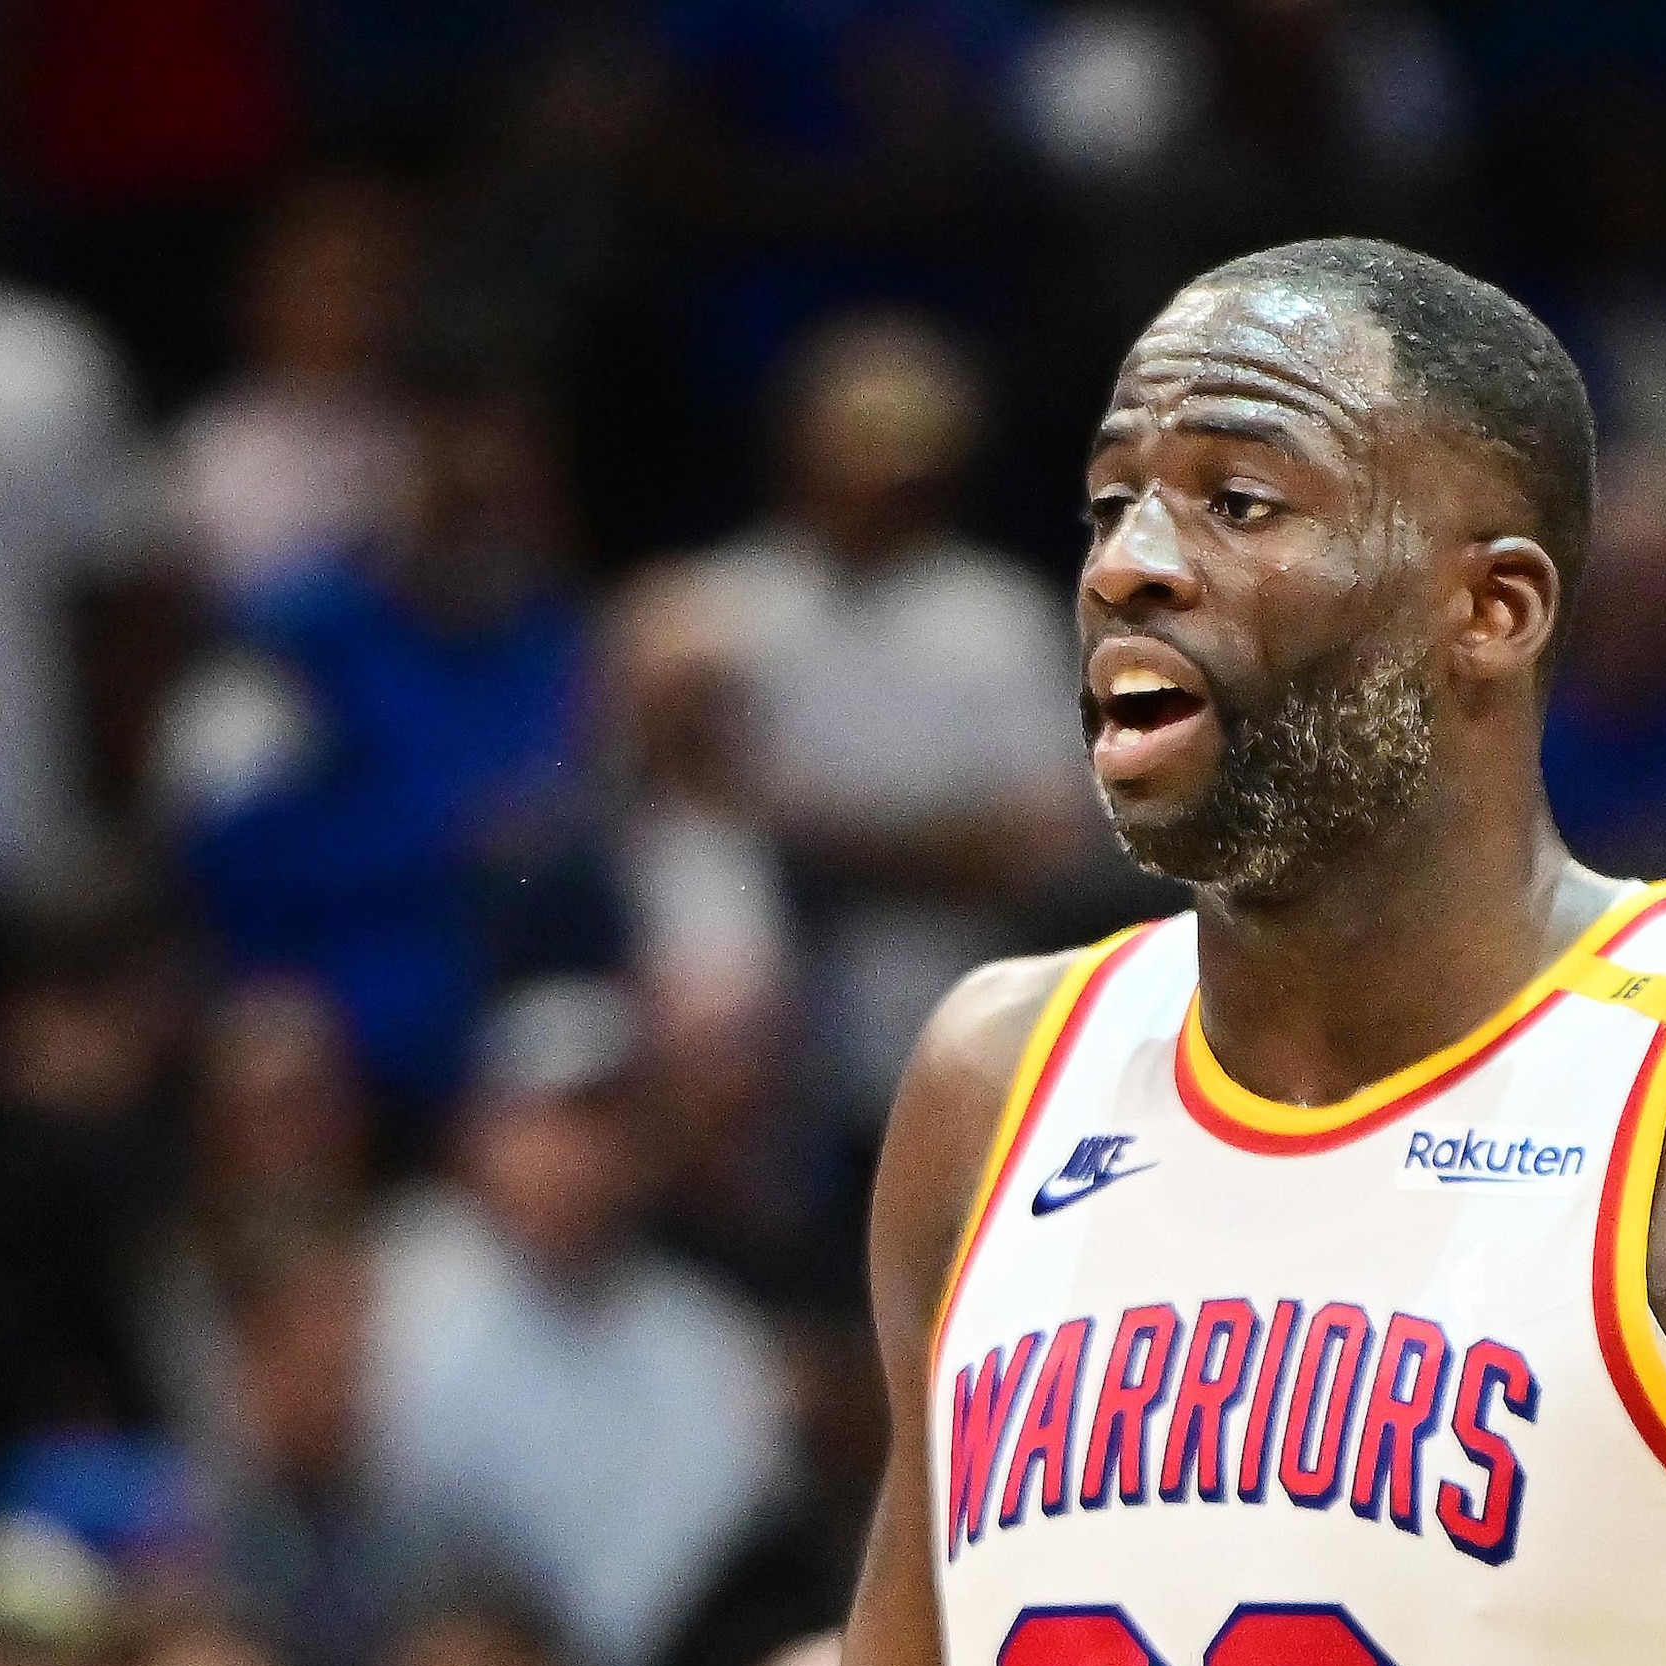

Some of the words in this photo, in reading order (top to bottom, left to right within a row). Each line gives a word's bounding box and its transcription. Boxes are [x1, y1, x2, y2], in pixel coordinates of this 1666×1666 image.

[1057, 1135, 1136, 1180] NIKE
[1404, 1130, 1585, 1177] Rakuten
[947, 1298, 1542, 1567] WARRIORS
